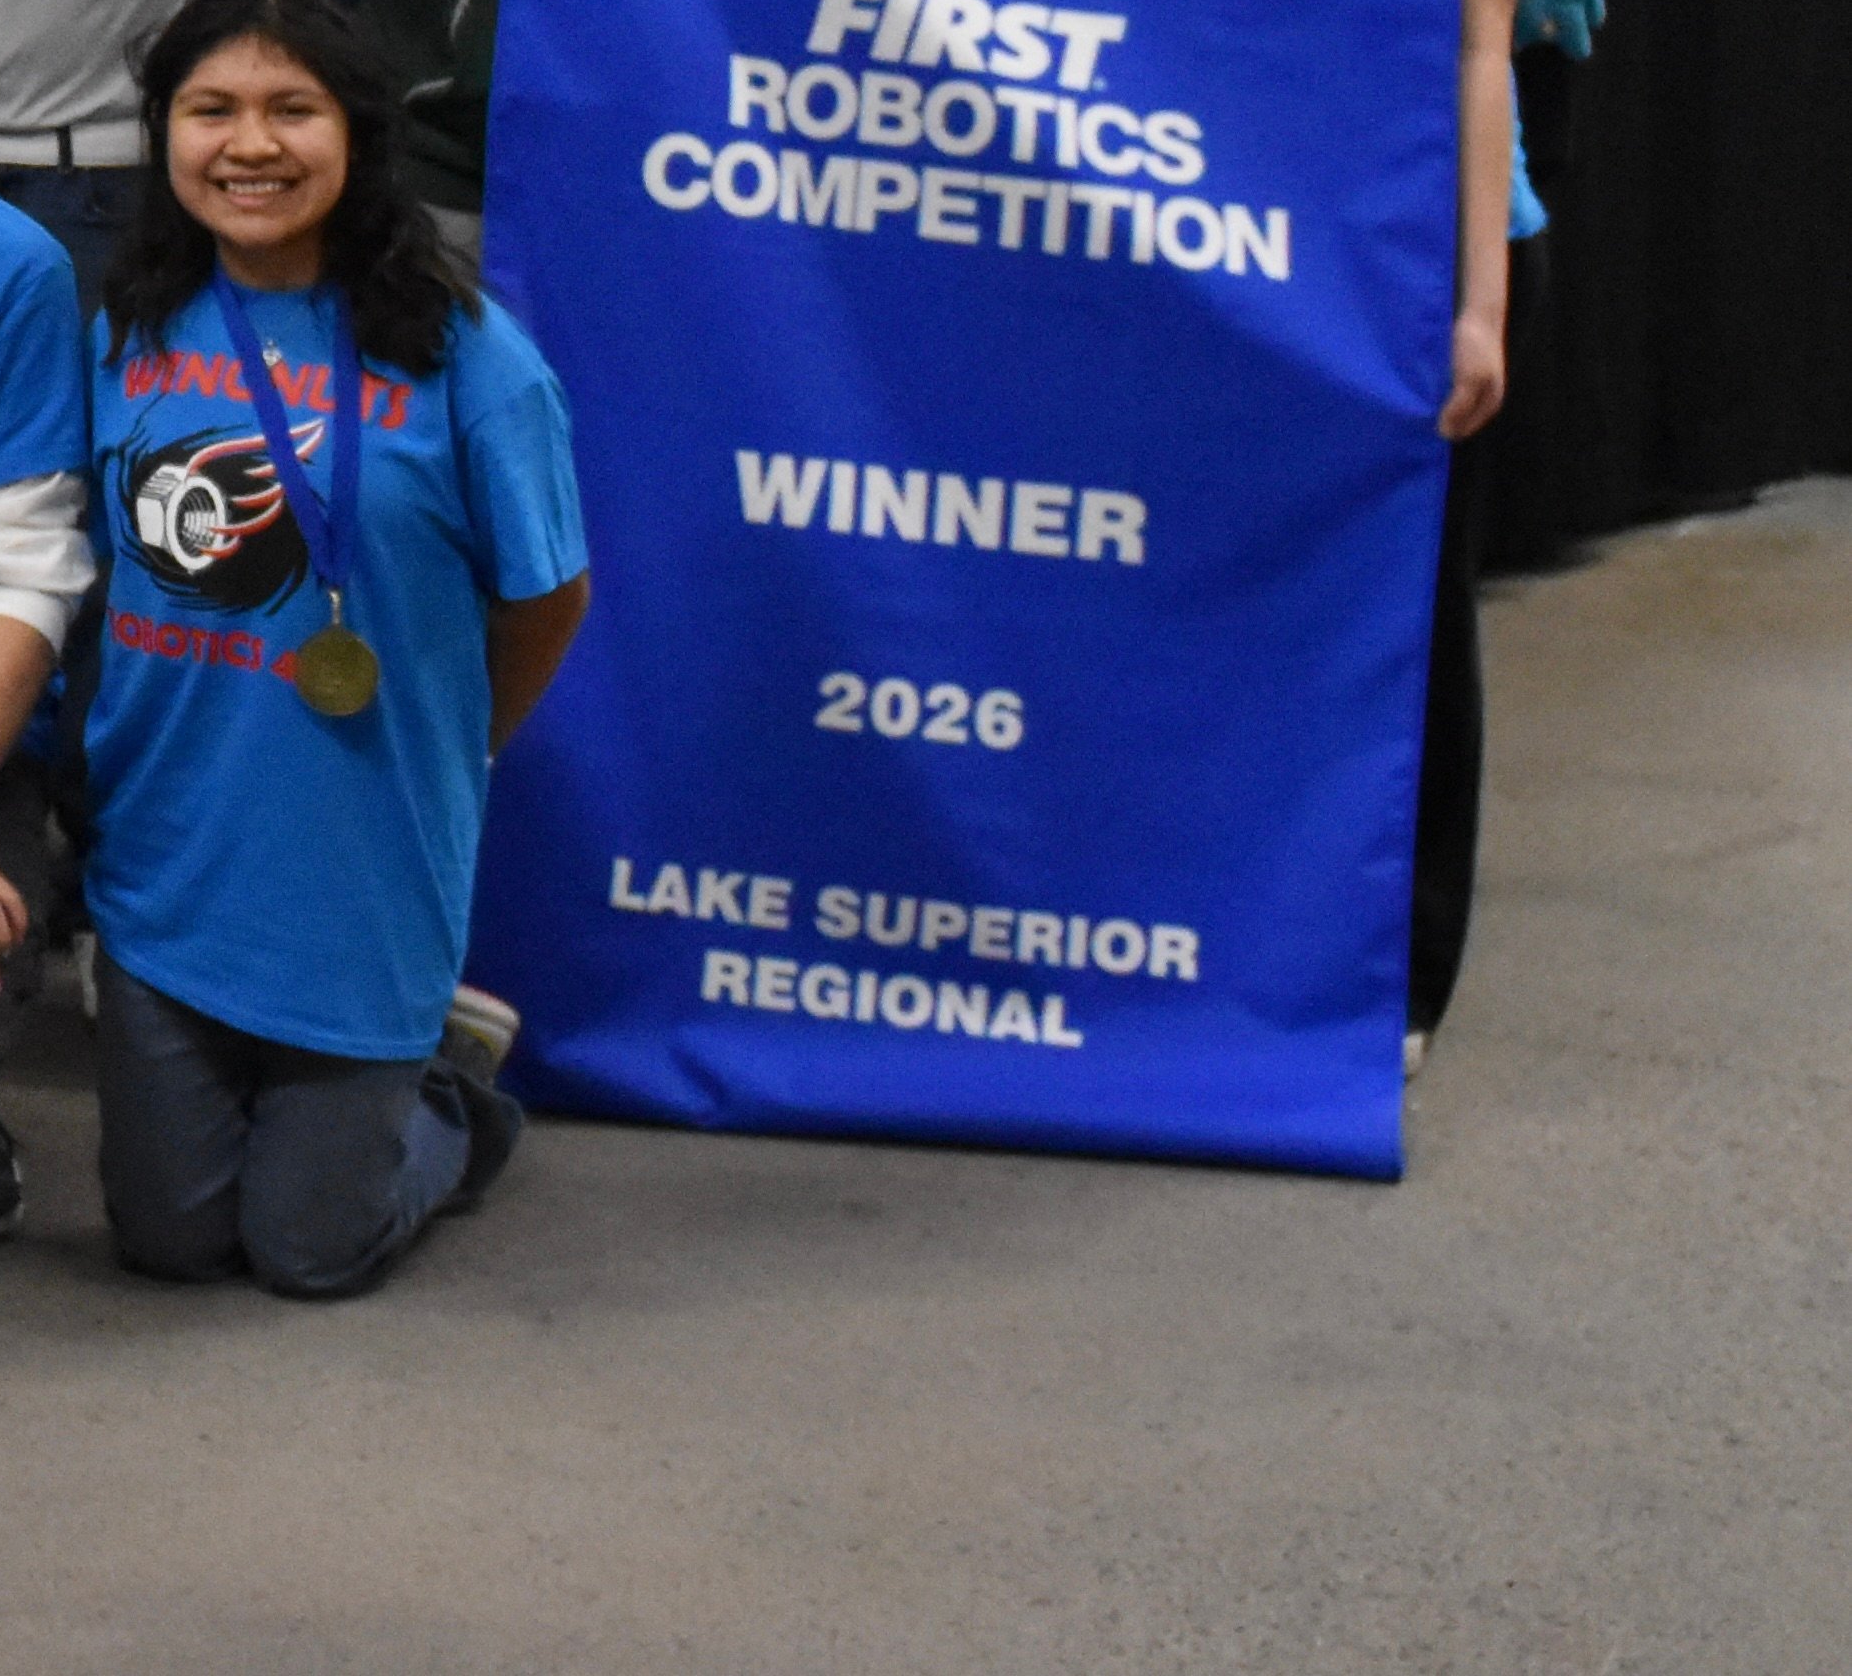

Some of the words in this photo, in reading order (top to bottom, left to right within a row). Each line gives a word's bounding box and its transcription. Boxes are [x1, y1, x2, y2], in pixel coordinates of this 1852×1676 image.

[727, 54, 1205, 186] ROBOTICS
[641, 132, 1293, 283] COMPETITION
[734, 448, 1148, 567] WINNER
[813, 672, 1025, 752] 2026
[608, 857, 793, 930] LAKE
[814, 885, 1199, 981] SUPERIOR
[700, 948, 1084, 1049] REGIONAL
